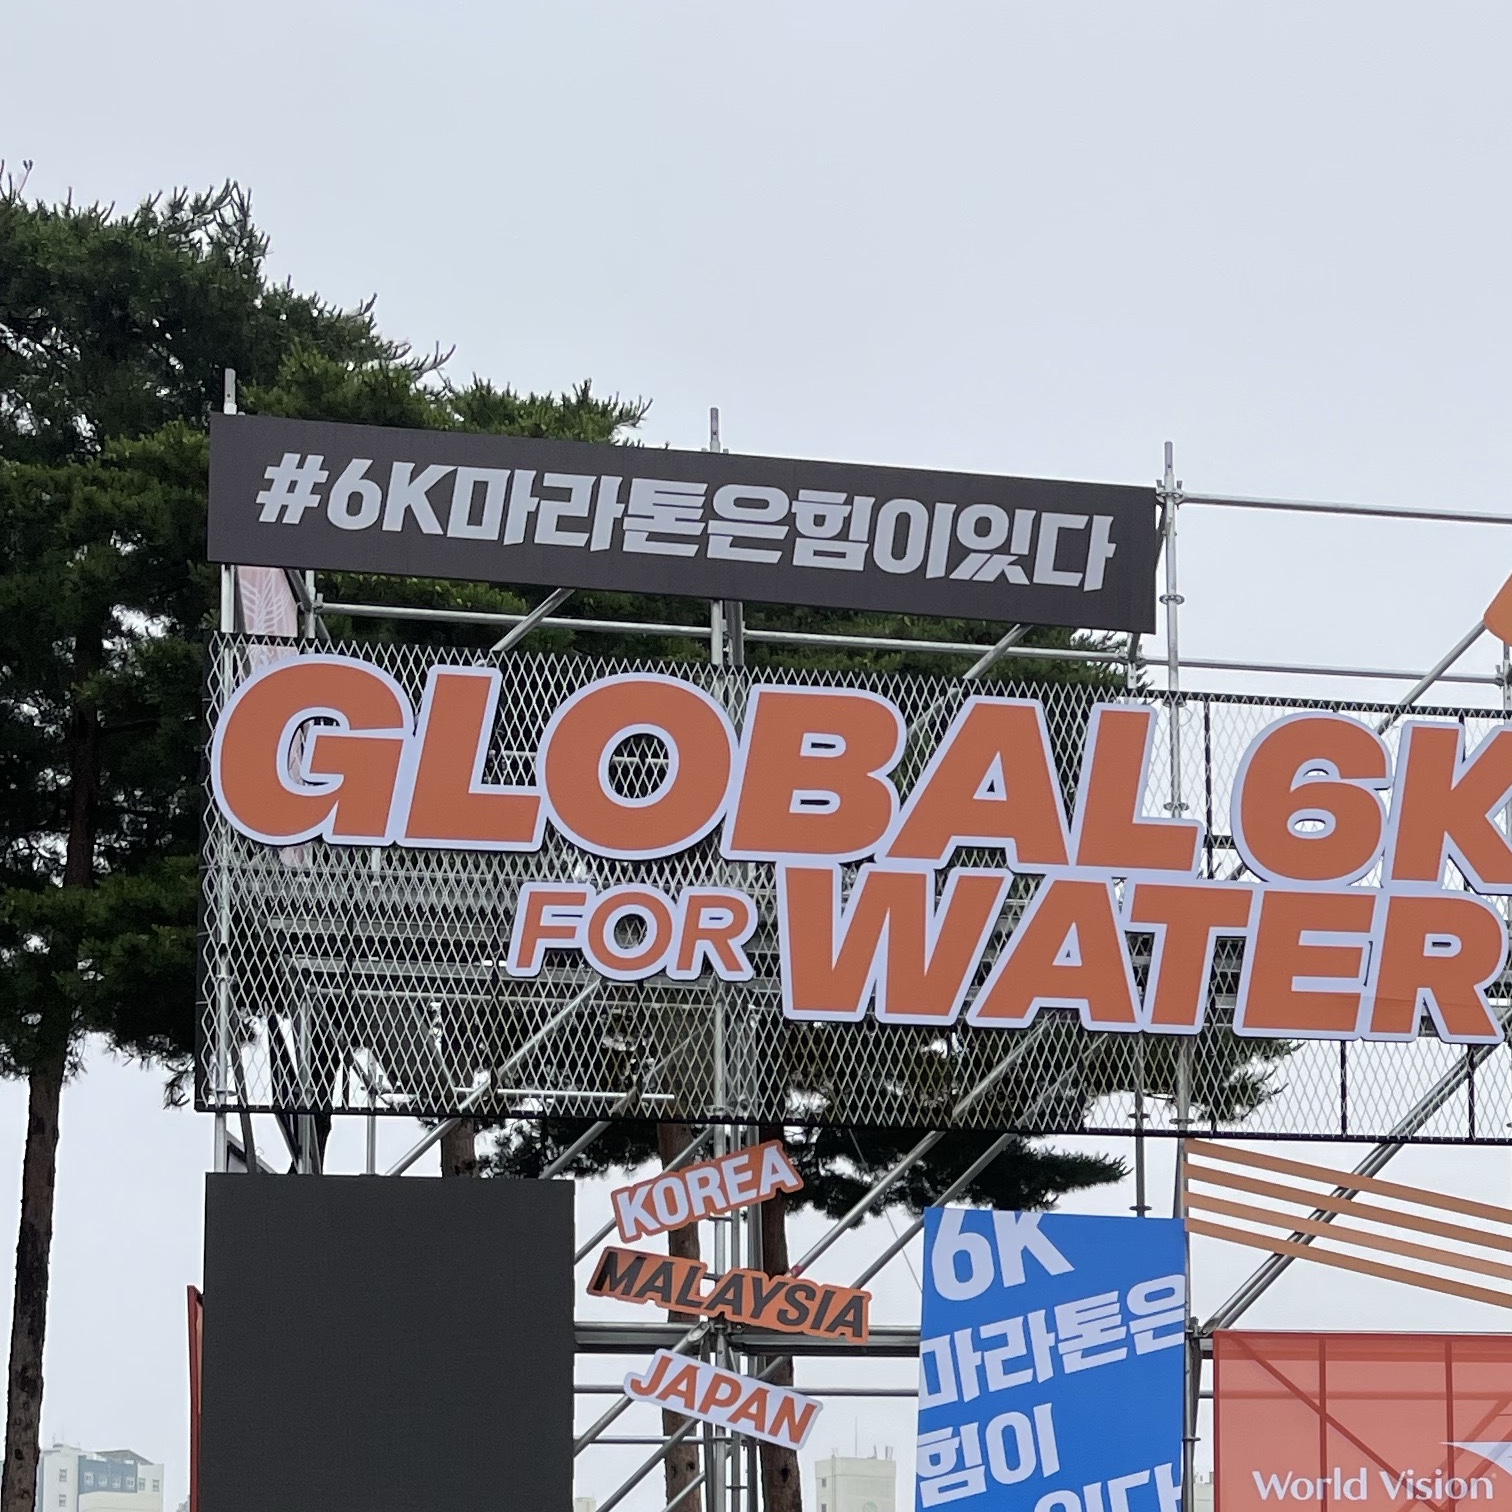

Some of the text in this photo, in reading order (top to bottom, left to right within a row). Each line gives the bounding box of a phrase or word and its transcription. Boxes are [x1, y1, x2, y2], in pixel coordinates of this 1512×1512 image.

[256, 452, 1116, 592] #6K마라톤은힘이있다
[213, 655, 1204, 877] GLOBAL
[507, 860, 1505, 1044] FOR WATER
[615, 1144, 798, 1240] KOREA
[593, 1251, 866, 1338] MALAYSIA
[931, 1208, 1075, 1301] 6K
[919, 1274, 1185, 1411] 마라톤은
[630, 1355, 818, 1444] JAPAN
[917, 1402, 1061, 1508] 힘이
[1252, 1467, 1494, 1501] World Vision
